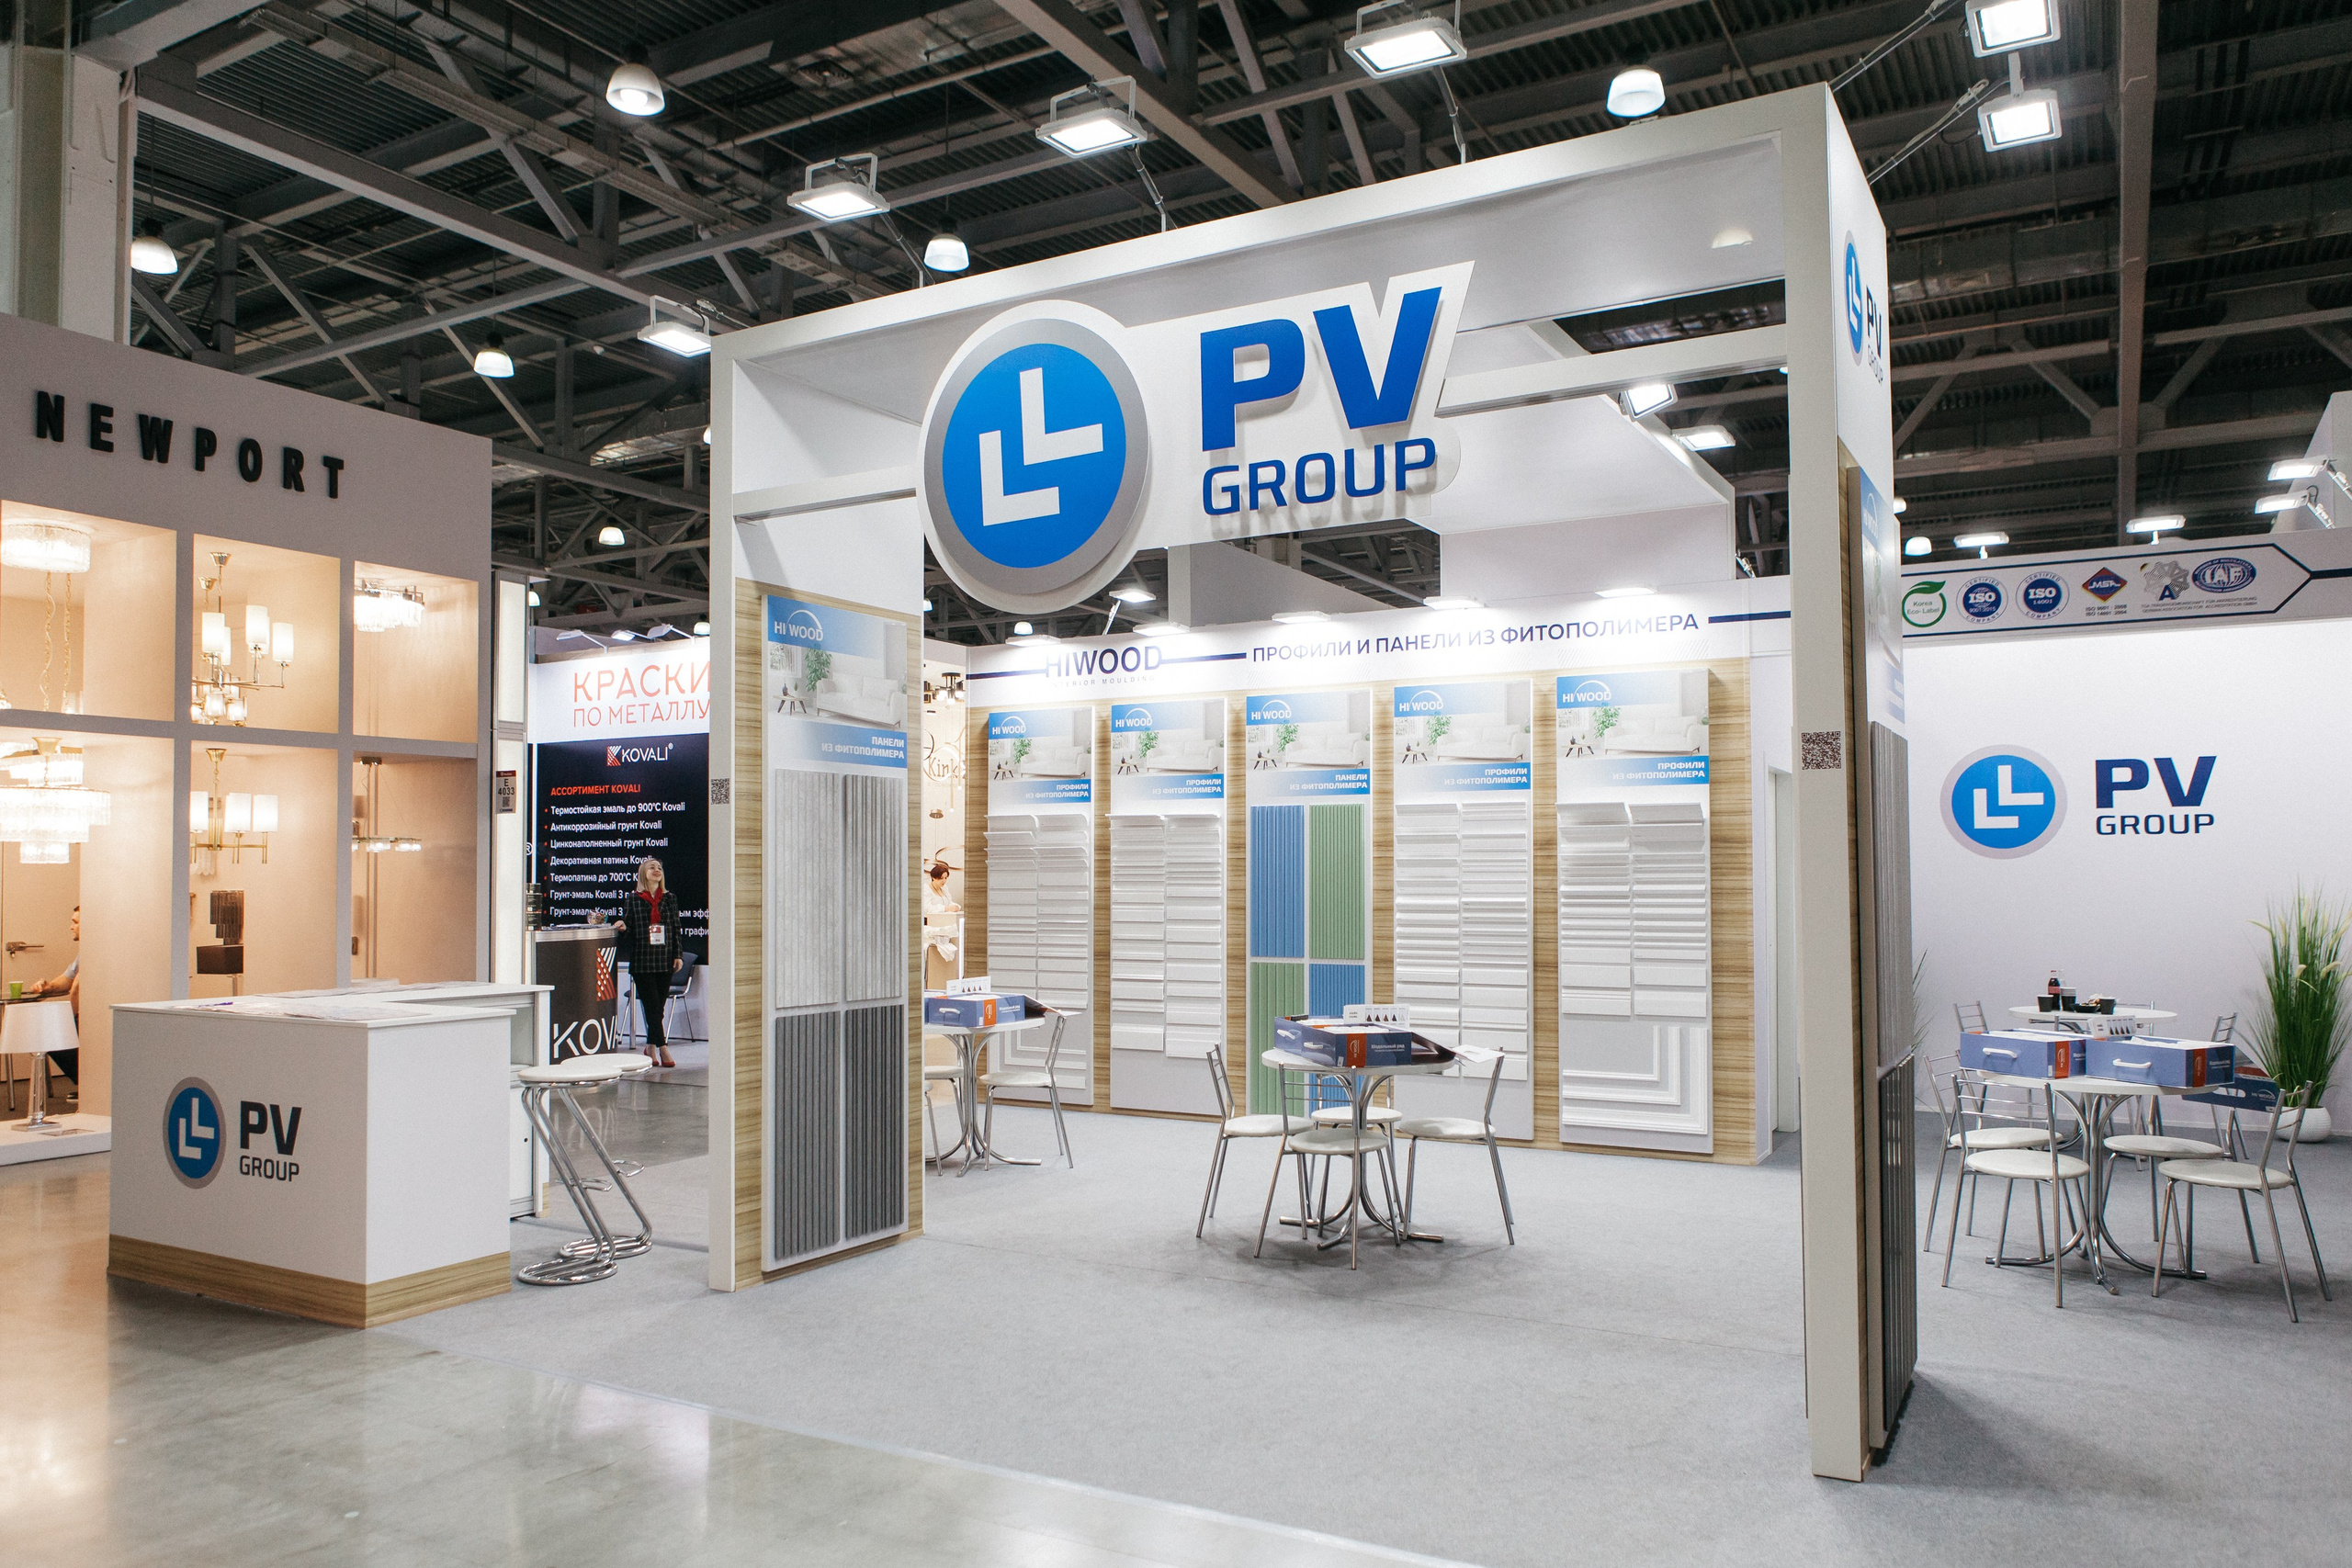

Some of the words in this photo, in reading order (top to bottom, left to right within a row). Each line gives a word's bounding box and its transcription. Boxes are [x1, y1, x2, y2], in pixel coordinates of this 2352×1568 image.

[1866, 285, 1882, 359] PV
[1200, 287, 1442, 452] PV
[35, 389, 345, 499] NEWPORT
[1203, 437, 1437, 516] GROUP
[1965, 577, 2000, 588] CERTIFIED
[1968, 592, 1996, 604] ISO
[2029, 587, 2056, 599] ISO
[774, 621, 786, 635] HI
[789, 623, 824, 641] WOOD
[1253, 640, 1351, 662] ПРОФИЛИ
[1358, 639, 1370, 655] И
[1376, 632, 1461, 653] ПАНЕЛИ
[1468, 629, 1495, 646] ИЗ
[1500, 613, 1699, 644] ФИТОПОЛИМЕРА
[1046, 646, 1162, 678] HIWOOD
[573, 660, 710, 703] КРАСКИ
[1053, 680, 1096, 688] TERIOR
[1563, 693, 1575, 703] HI
[1576, 690, 1611, 703] WOOD
[1399, 703, 1409, 712] HI
[1410, 700, 1444, 712] WOOD
[573, 706, 602, 728] ПО
[608, 698, 710, 726] МЕТАЛЛУ
[1251, 711, 1261, 721] HI
[1262, 708, 1292, 720] WOOD
[1114, 719, 1125, 728] HI
[1125, 716, 1153, 728] WOOD
[992, 727, 1001, 736] HI
[1001, 724, 1027, 735] WOOD
[872, 736, 905, 748] ПАНЕЛИ
[821, 743, 833, 752] ИЗ
[834, 744, 905, 760] ФИТОПОЛИМЕРА
[928, 757, 958, 779] Kink
[1485, 767, 1527, 776] ПРОФИЛИ
[1657, 761, 1705, 771] ПРОФИЛИ
[1455, 775, 1528, 785] ФИТОПОЛИМЕРА
[1612, 772, 1624, 780] ИЗ
[1626, 770, 1705, 780] ФИТОПОЛИМЕРА
[503, 778, 509, 786] E
[1186, 778, 1222, 786] ПРОФИЛИ
[1301, 782, 1368, 791] ФИТОПОЛИМЕРА
[2096, 756, 2217, 809] PV
[497, 787, 515, 795] 4033
[550, 785, 609, 796] АССОРТИМЕНТ
[611, 784, 641, 794] KOVALI
[1035, 791, 1090, 799] ФИТОПОЛИМЕРА
[1162, 785, 1222, 795] ФИТОПОЛИМЕРА
[551, 805, 602, 816] Термостойкая
[603, 806, 625, 814] эмаль
[627, 806, 636, 814] до
[662, 802, 685, 812] Kovali
[550, 821, 616, 832] Антикоррозийный
[617, 822, 638, 831] грунт
[639, 820, 662, 829] Kovali
[2096, 814, 2215, 836] GROUP
[550, 838, 622, 850] Цинконаполненный
[624, 840, 644, 850] грунт
[646, 838, 668, 847] Kovali
[550, 856, 602, 866] Декоративная
[550, 873, 597, 884] Термопатина
[549, 890, 594, 900] Грунт-эмаль
[594, 889, 616, 898] Kovali
[618, 890, 624, 898] 3
[594, 907, 616, 916] Kovali
[618, 908, 624, 916] 3
[240, 1100, 302, 1156] PV
[239, 1155, 300, 1182] GROUP
